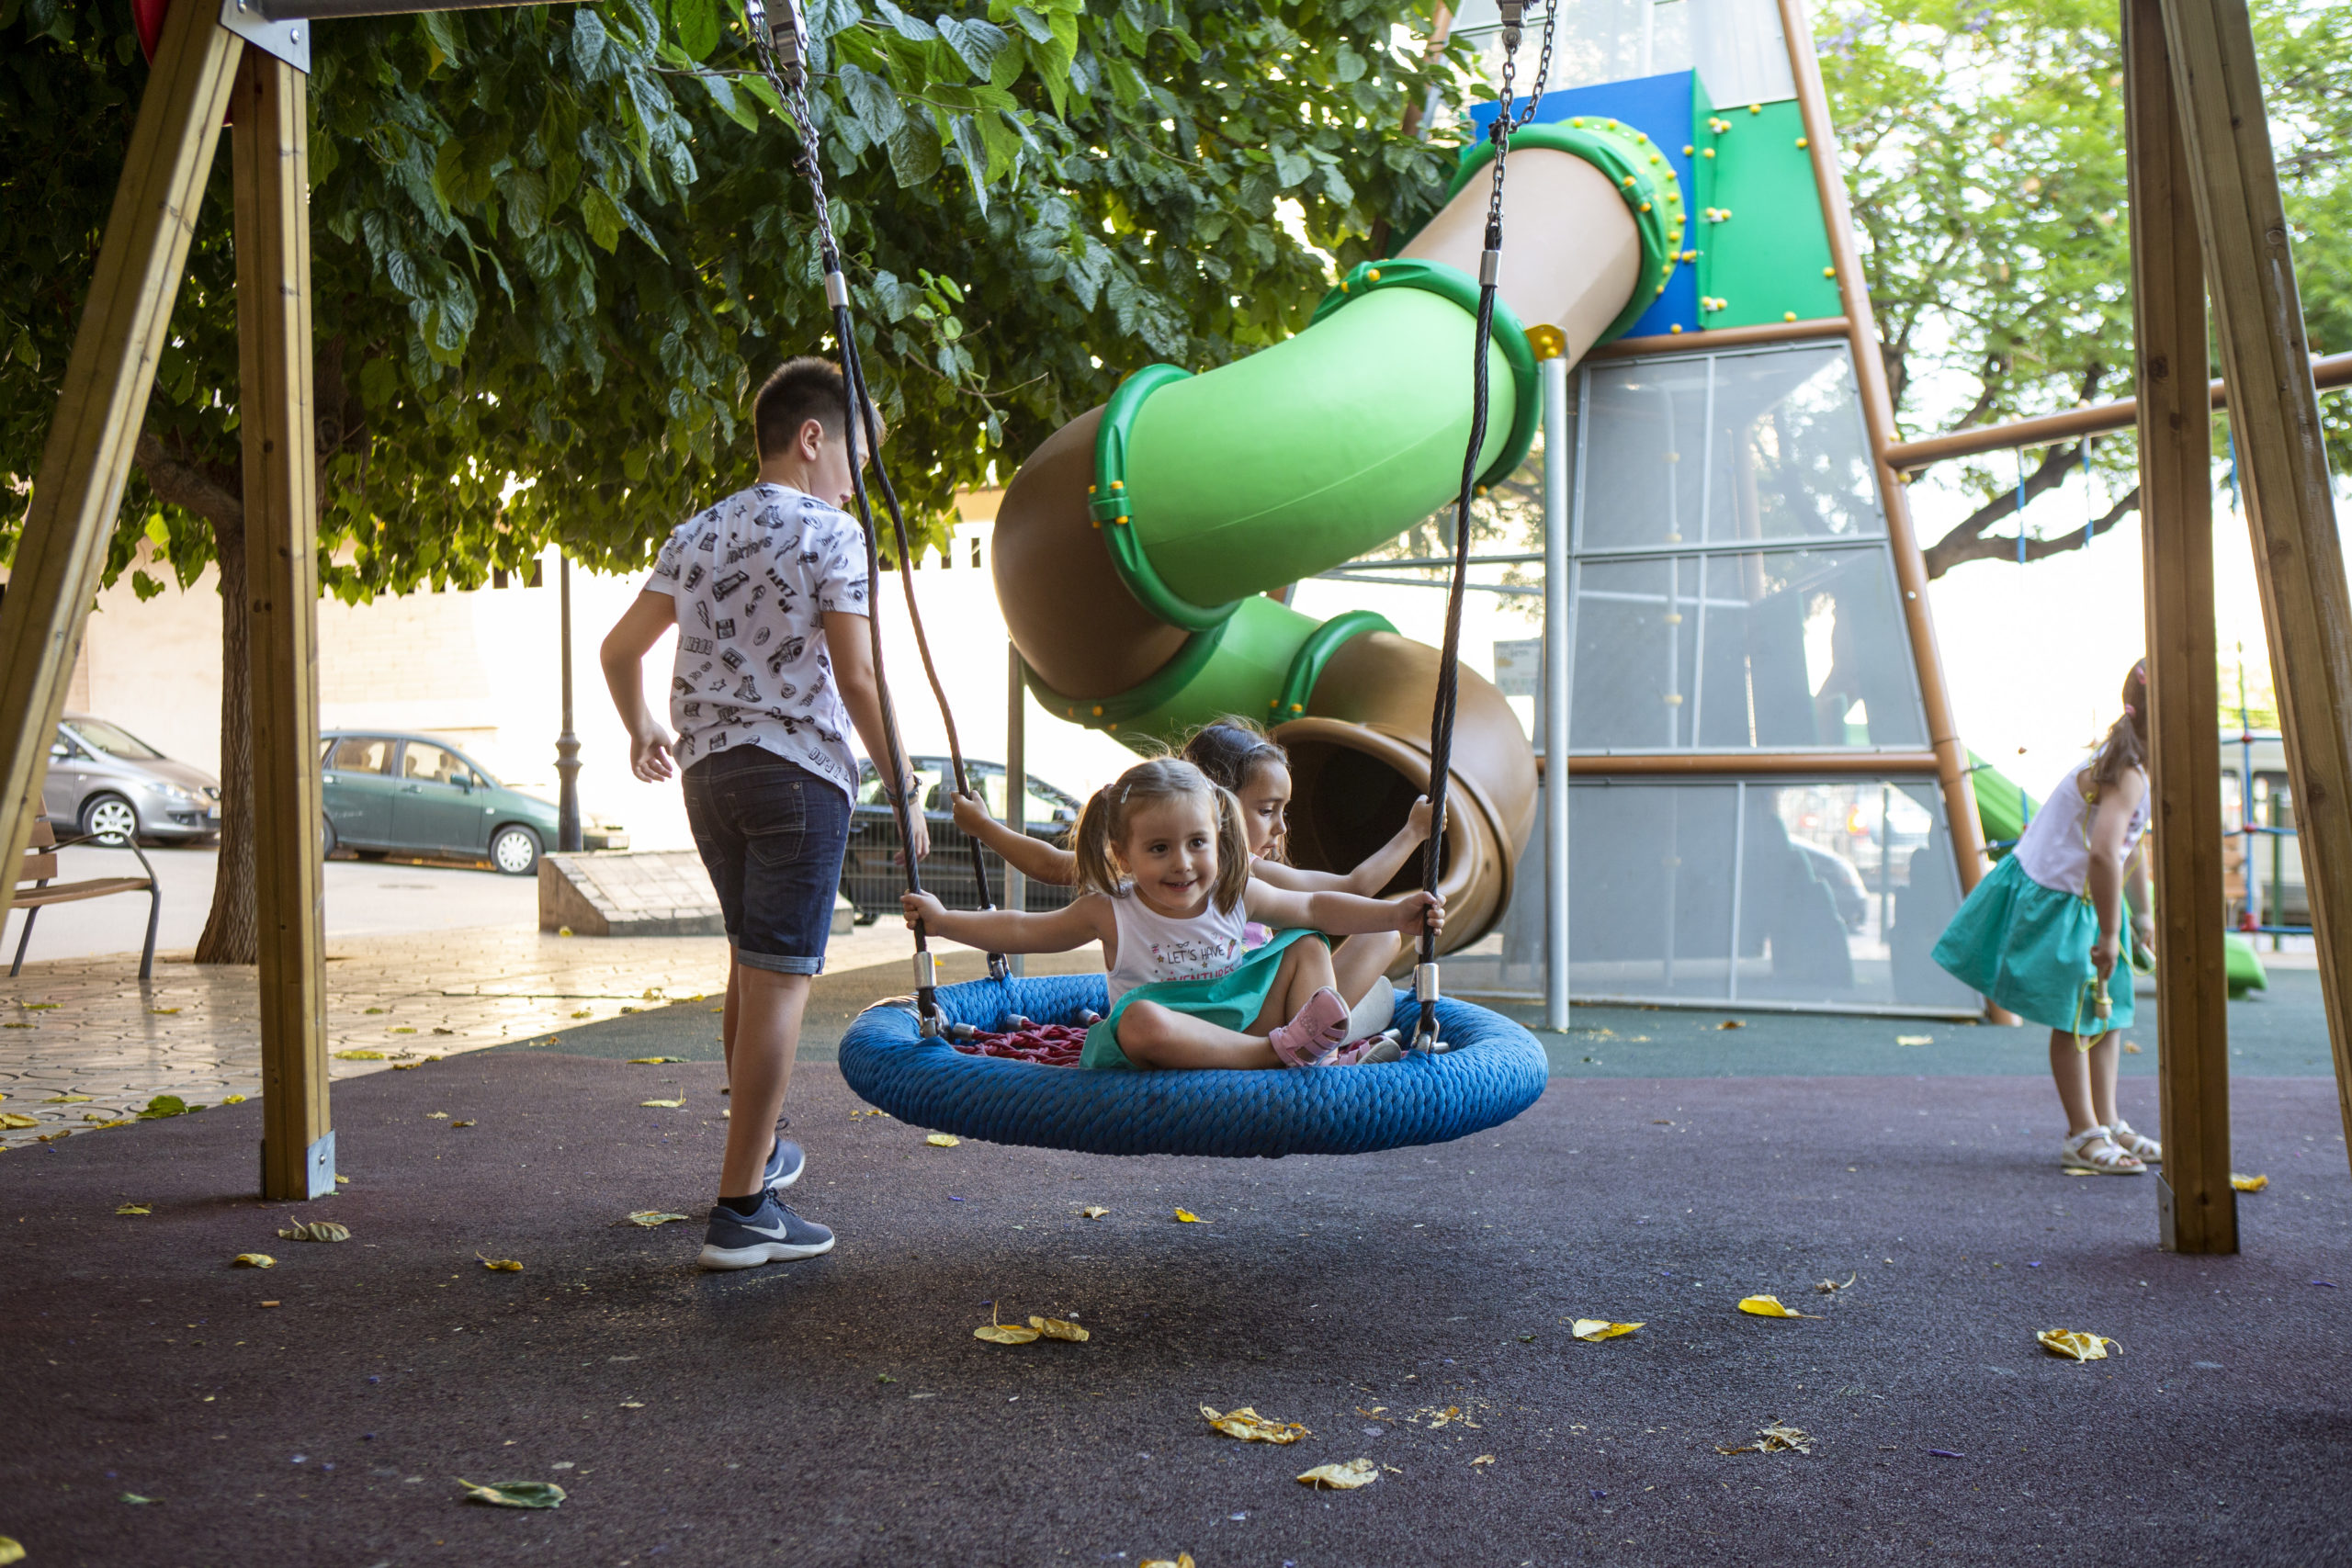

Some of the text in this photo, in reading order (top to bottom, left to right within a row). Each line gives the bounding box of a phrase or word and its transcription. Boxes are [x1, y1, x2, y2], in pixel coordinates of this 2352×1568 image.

[765, 567, 798, 598] PARTY
[778, 598, 793, 614] ON
[1167, 943, 1225, 964] LET'S HAVE
